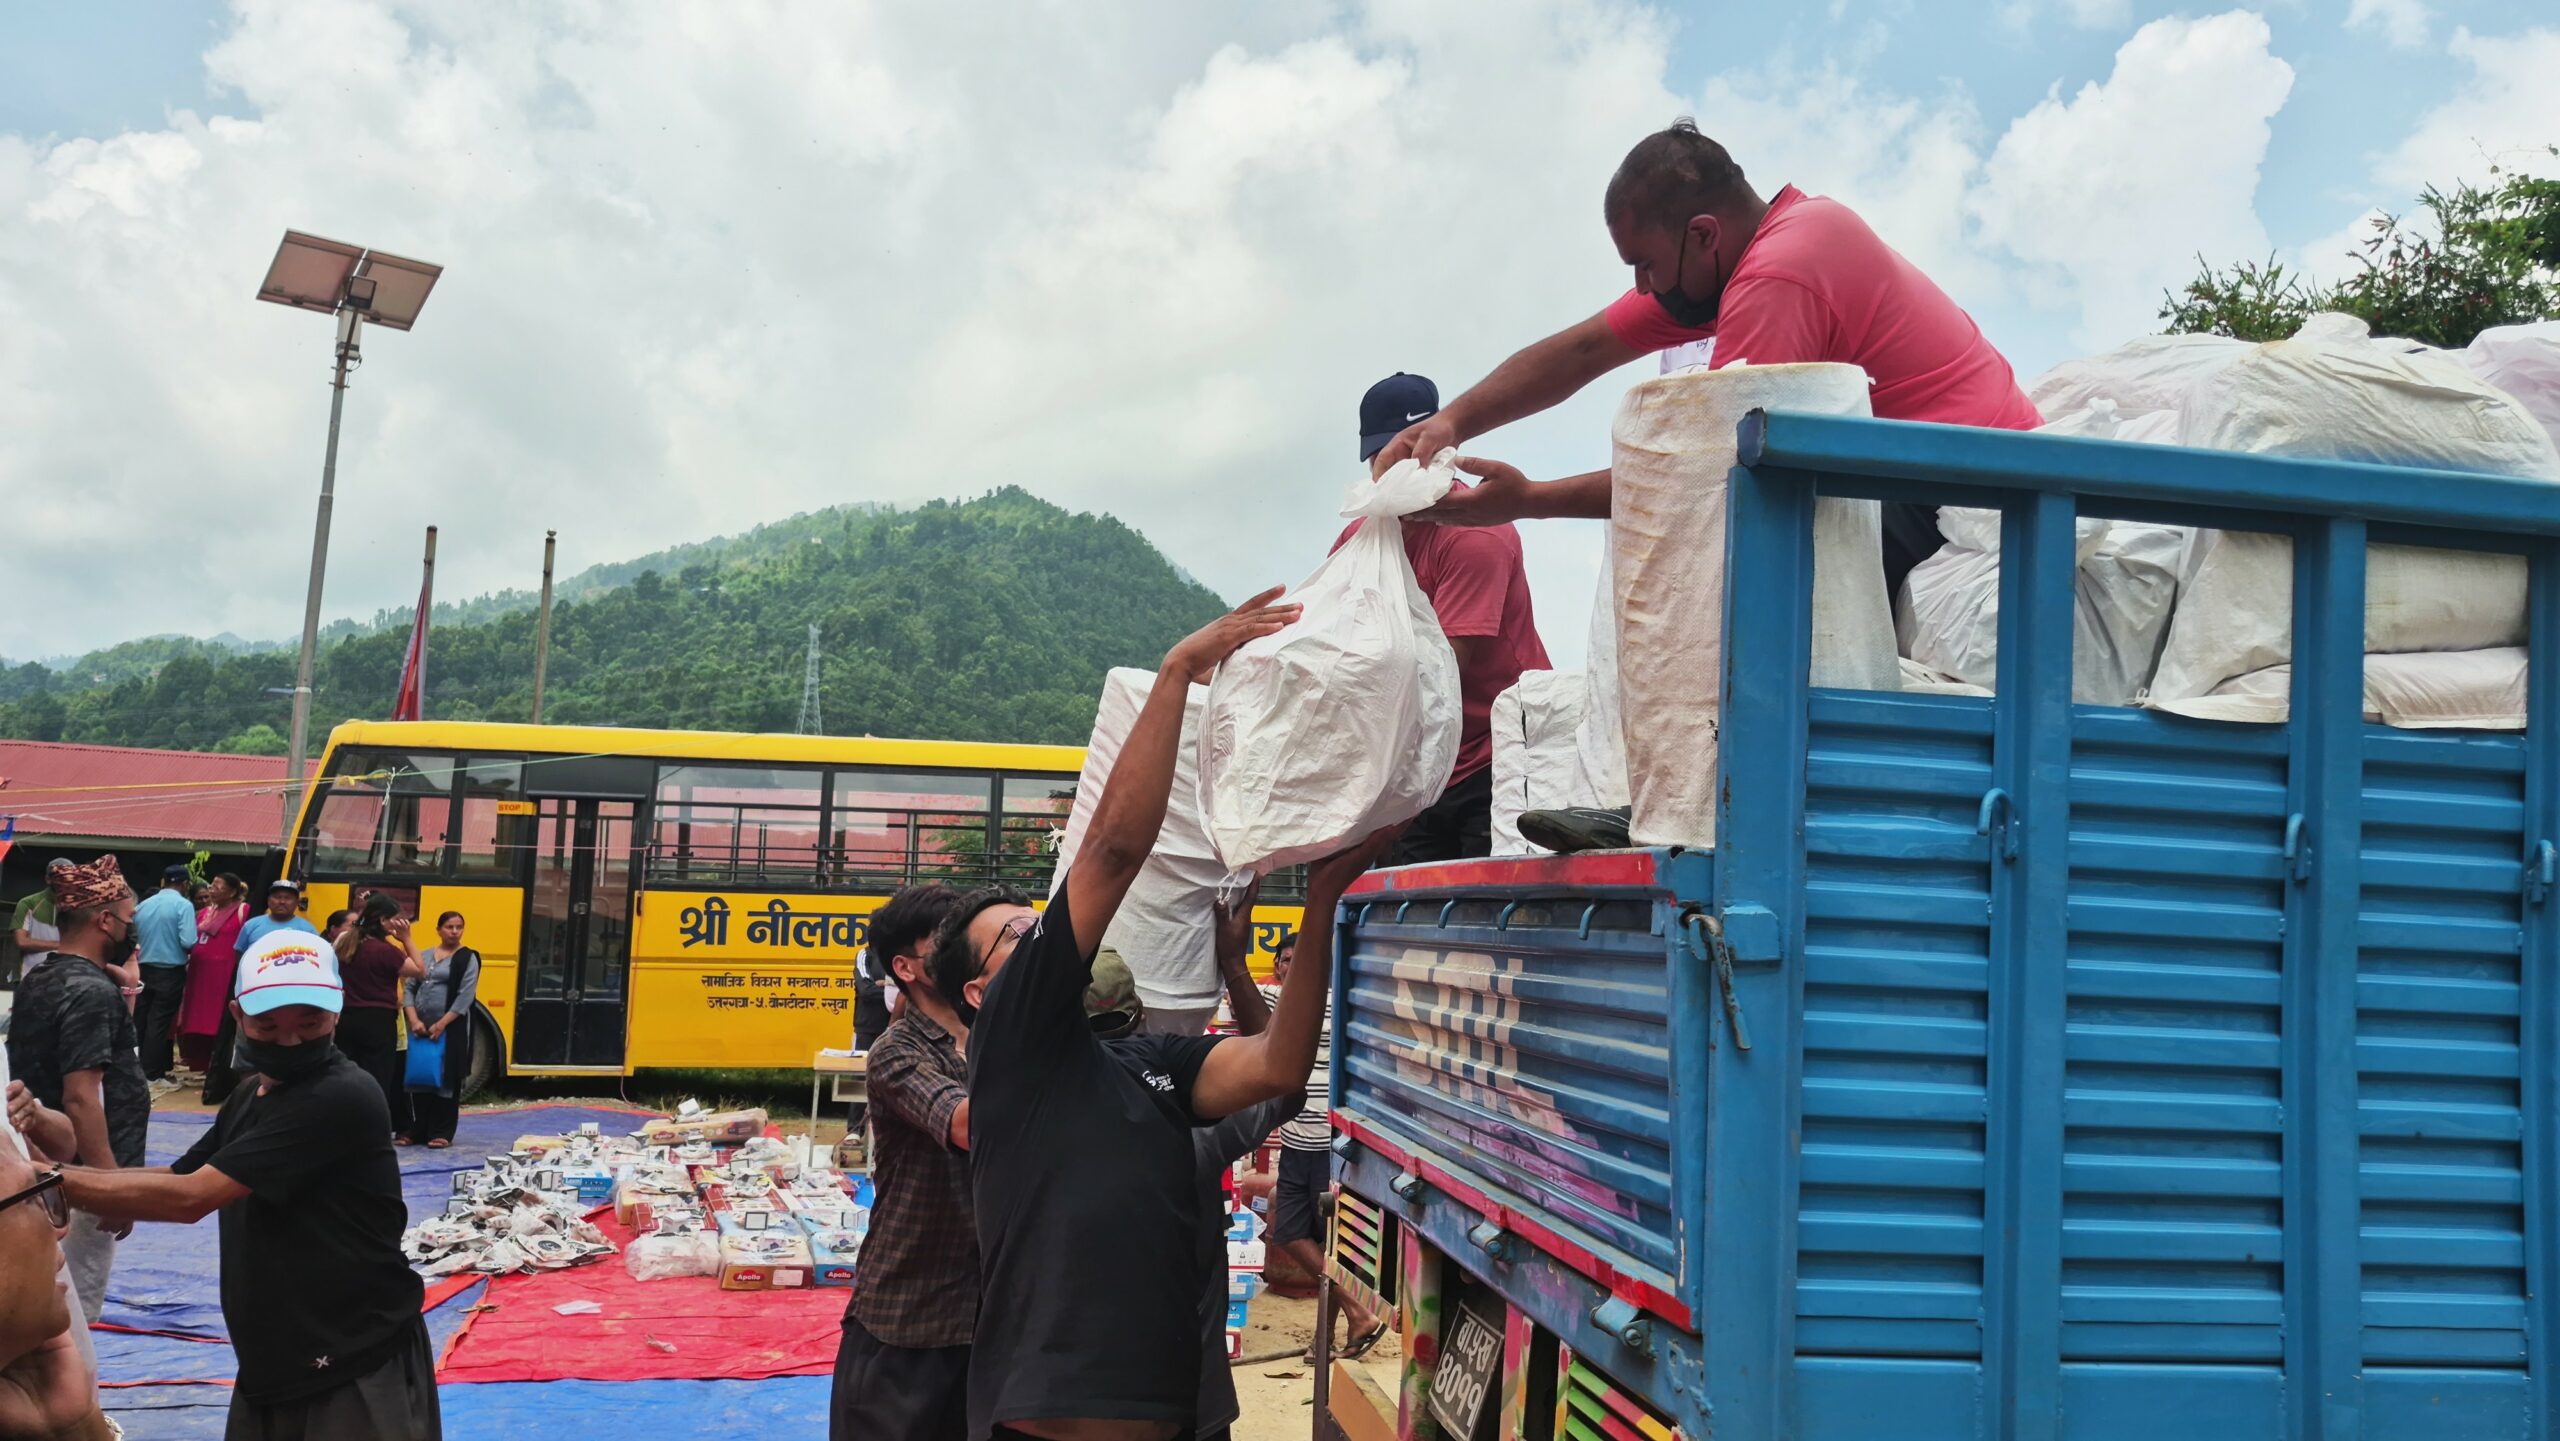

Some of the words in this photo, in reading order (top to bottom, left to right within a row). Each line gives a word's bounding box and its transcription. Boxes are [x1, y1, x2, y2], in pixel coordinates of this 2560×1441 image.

[498, 803, 521, 812] STOP
[679, 896, 731, 949] श्री
[746, 898, 870, 948] नीलक
[273, 955, 305, 967] CAP
[701, 972, 746, 989] सामाजिक
[751, 972, 782, 988] विकास
[737, 1273, 761, 1282] Apollo
[828, 1270, 851, 1280] Apollo
